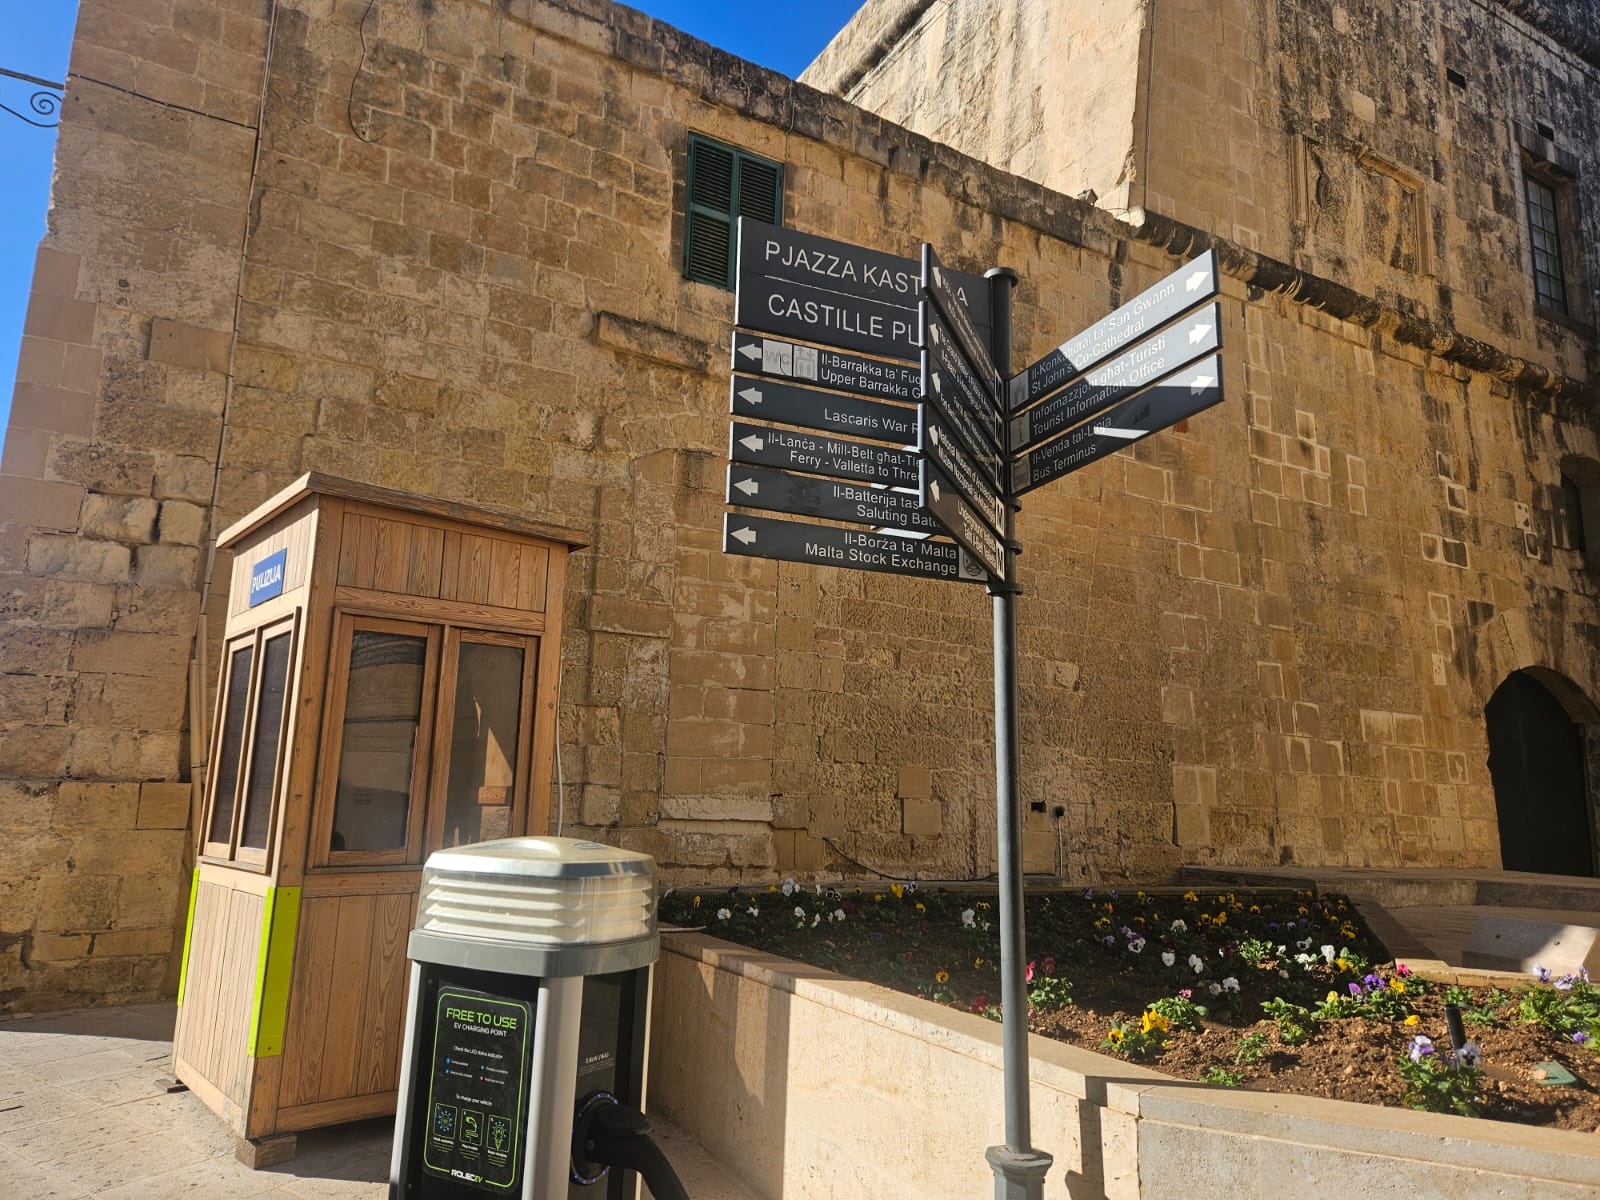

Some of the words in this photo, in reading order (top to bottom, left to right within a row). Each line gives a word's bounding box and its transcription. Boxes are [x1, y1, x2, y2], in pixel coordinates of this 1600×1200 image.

[765, 240, 857, 282] PJAZZA
[768, 293, 884, 338] CASTILLE
[1108, 311, 1130, 332] San
[765, 349, 790, 366] WC
[821, 353, 882, 377] Il-Barrakka
[885, 367, 899, 380] ta'
[1031, 381, 1042, 394] St
[1043, 362, 1073, 388] John's
[1074, 316, 1145, 367] Co-Cathedral
[821, 368, 856, 386] Upper
[859, 376, 908, 397] Barrakka
[1033, 412, 1065, 436] Tourist
[1067, 378, 1126, 418] Information
[1129, 357, 1165, 383] Office
[1032, 378, 1098, 422] Informazzjoni
[824, 408, 879, 428] Lascaris
[882, 417, 908, 433] War
[768, 432, 815, 451] Il-Lanċa
[827, 441, 874, 460] Mill-Belt
[1033, 439, 1070, 465] Il-Venda
[1072, 416, 1112, 445] tal-Linja
[790, 450, 821, 469] Ferry
[833, 457, 875, 475] Valletta
[878, 465, 889, 477] to
[892, 466, 920, 481] Thre
[1033, 466, 1051, 482] Bus
[1052, 443, 1097, 472] Terminus
[833, 485, 897, 508] Il-Batterija
[856, 504, 908, 526] Saluting
[912, 512, 939, 527] Batt
[805, 542, 844, 560] Malta
[849, 549, 887, 565] Stock
[891, 554, 957, 576] Exchange
[844, 532, 897, 551] Il-Borża
[901, 541, 918, 553] ta'
[921, 543, 957, 559] Malta
[446, 1007, 475, 1022] FREE
[476, 1012, 492, 1025] TO
[493, 1015, 518, 1030] USE
[453, 1022, 462, 1030] EV
[462, 1023, 490, 1034] CHARGING
[490, 1028, 507, 1037] POINT
